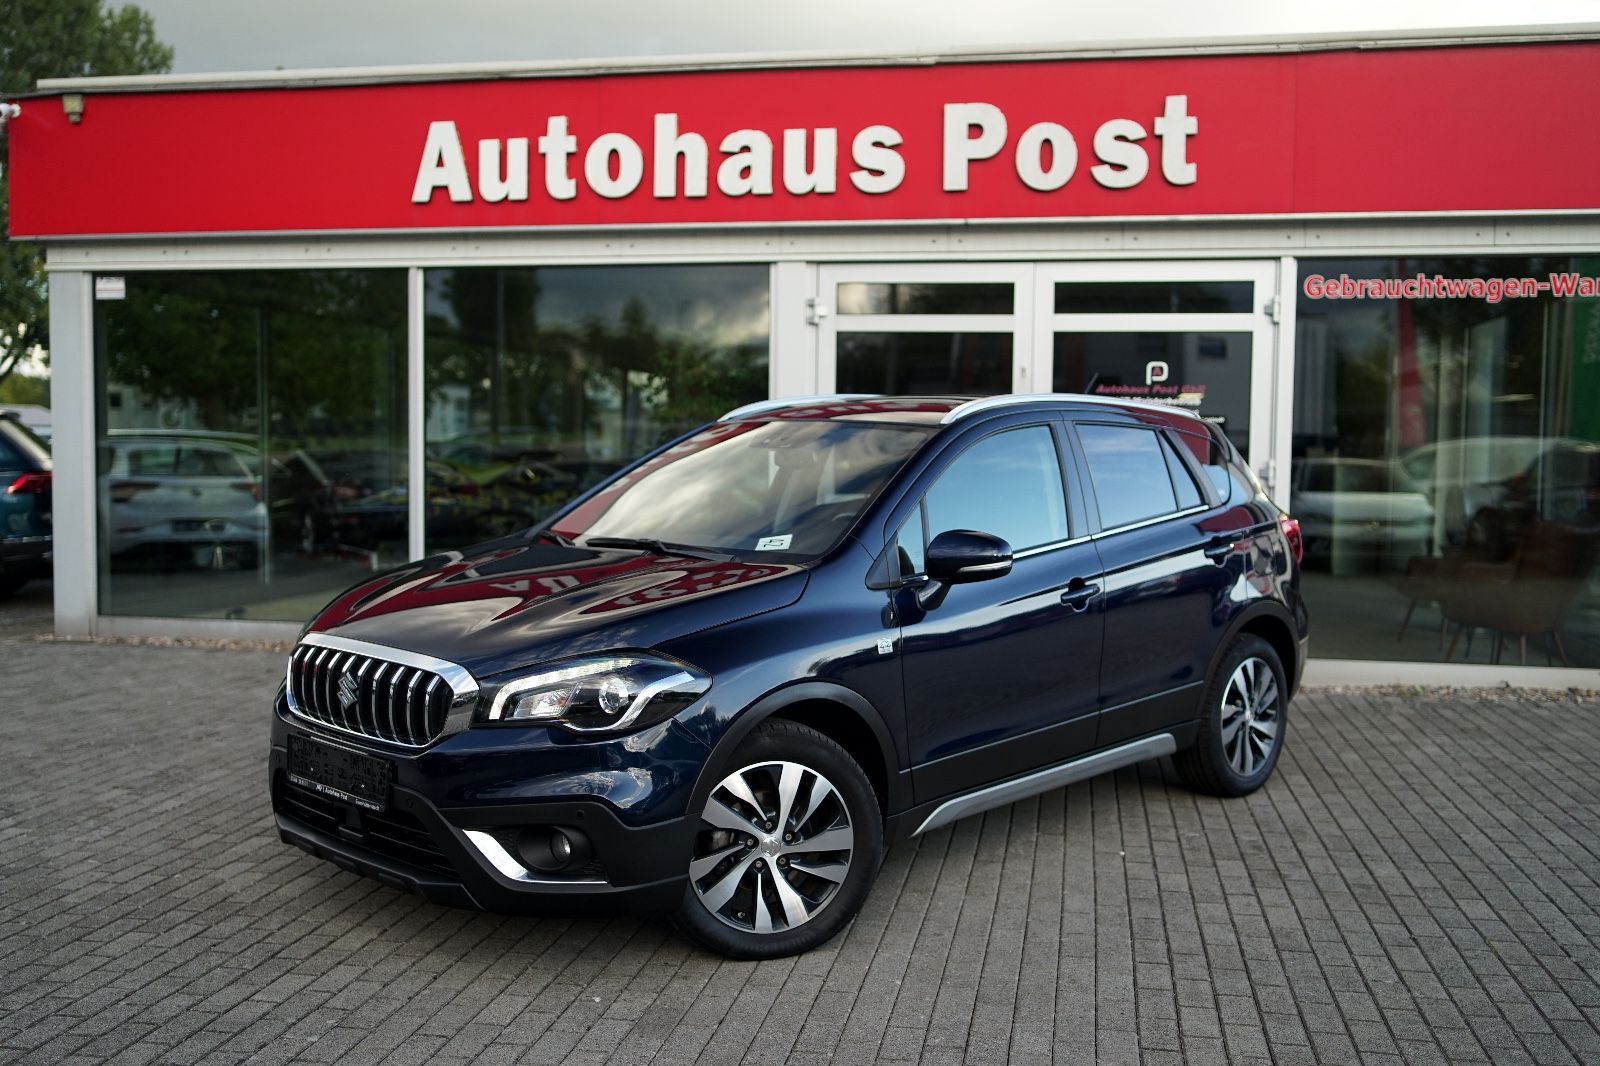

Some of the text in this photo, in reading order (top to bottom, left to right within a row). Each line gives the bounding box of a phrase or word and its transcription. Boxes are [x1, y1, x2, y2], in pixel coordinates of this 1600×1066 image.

[411, 94, 1199, 204] Autohaus Post
[1095, 384, 1149, 394] Autohaus
[1152, 384, 1178, 394] Post
